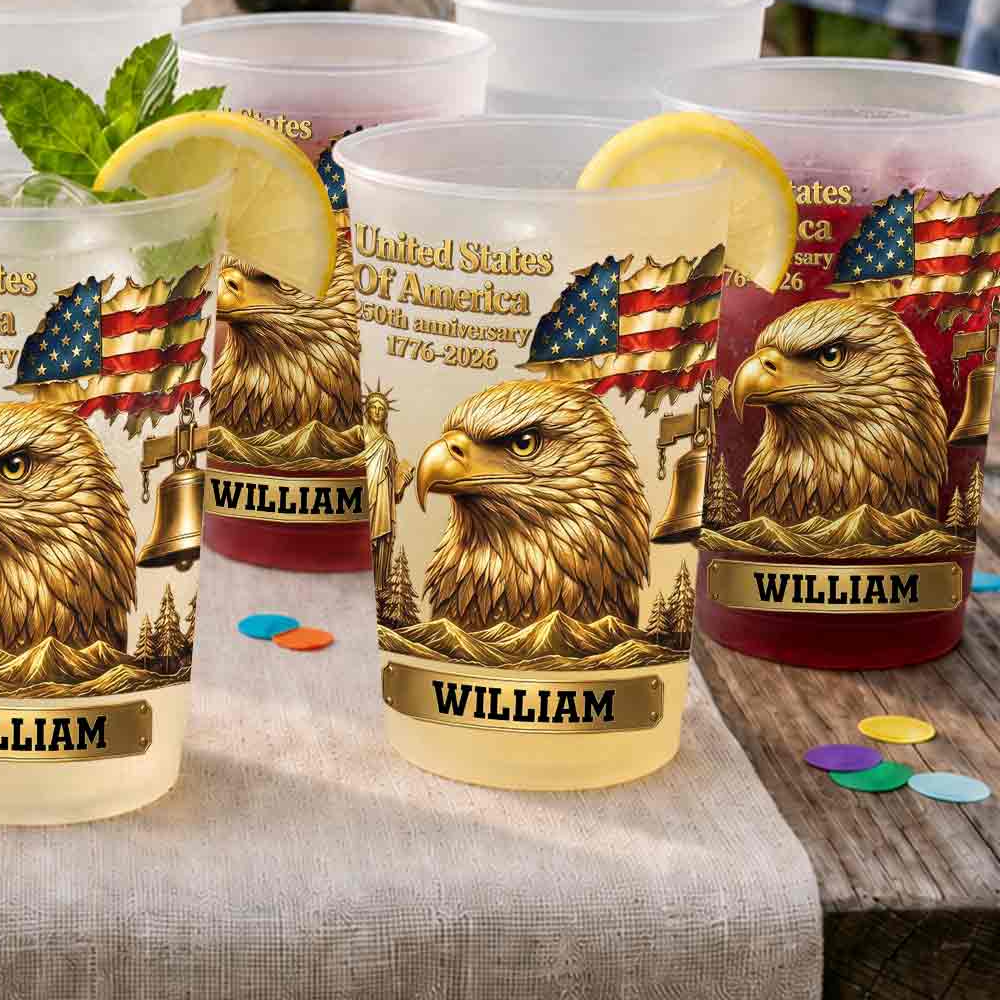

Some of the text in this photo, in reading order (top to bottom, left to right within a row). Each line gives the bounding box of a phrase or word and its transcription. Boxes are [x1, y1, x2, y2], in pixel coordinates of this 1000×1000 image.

[354, 223, 554, 277] United States
[353, 263, 531, 315] Of America
[360, 303, 534, 348] 50th anniversary
[386, 335, 498, 369] 1776-2026
[210, 478, 363, 514] WILLIAM
[753, 572, 920, 604] WILLIAM
[432, 680, 616, 723] WILLIAM
